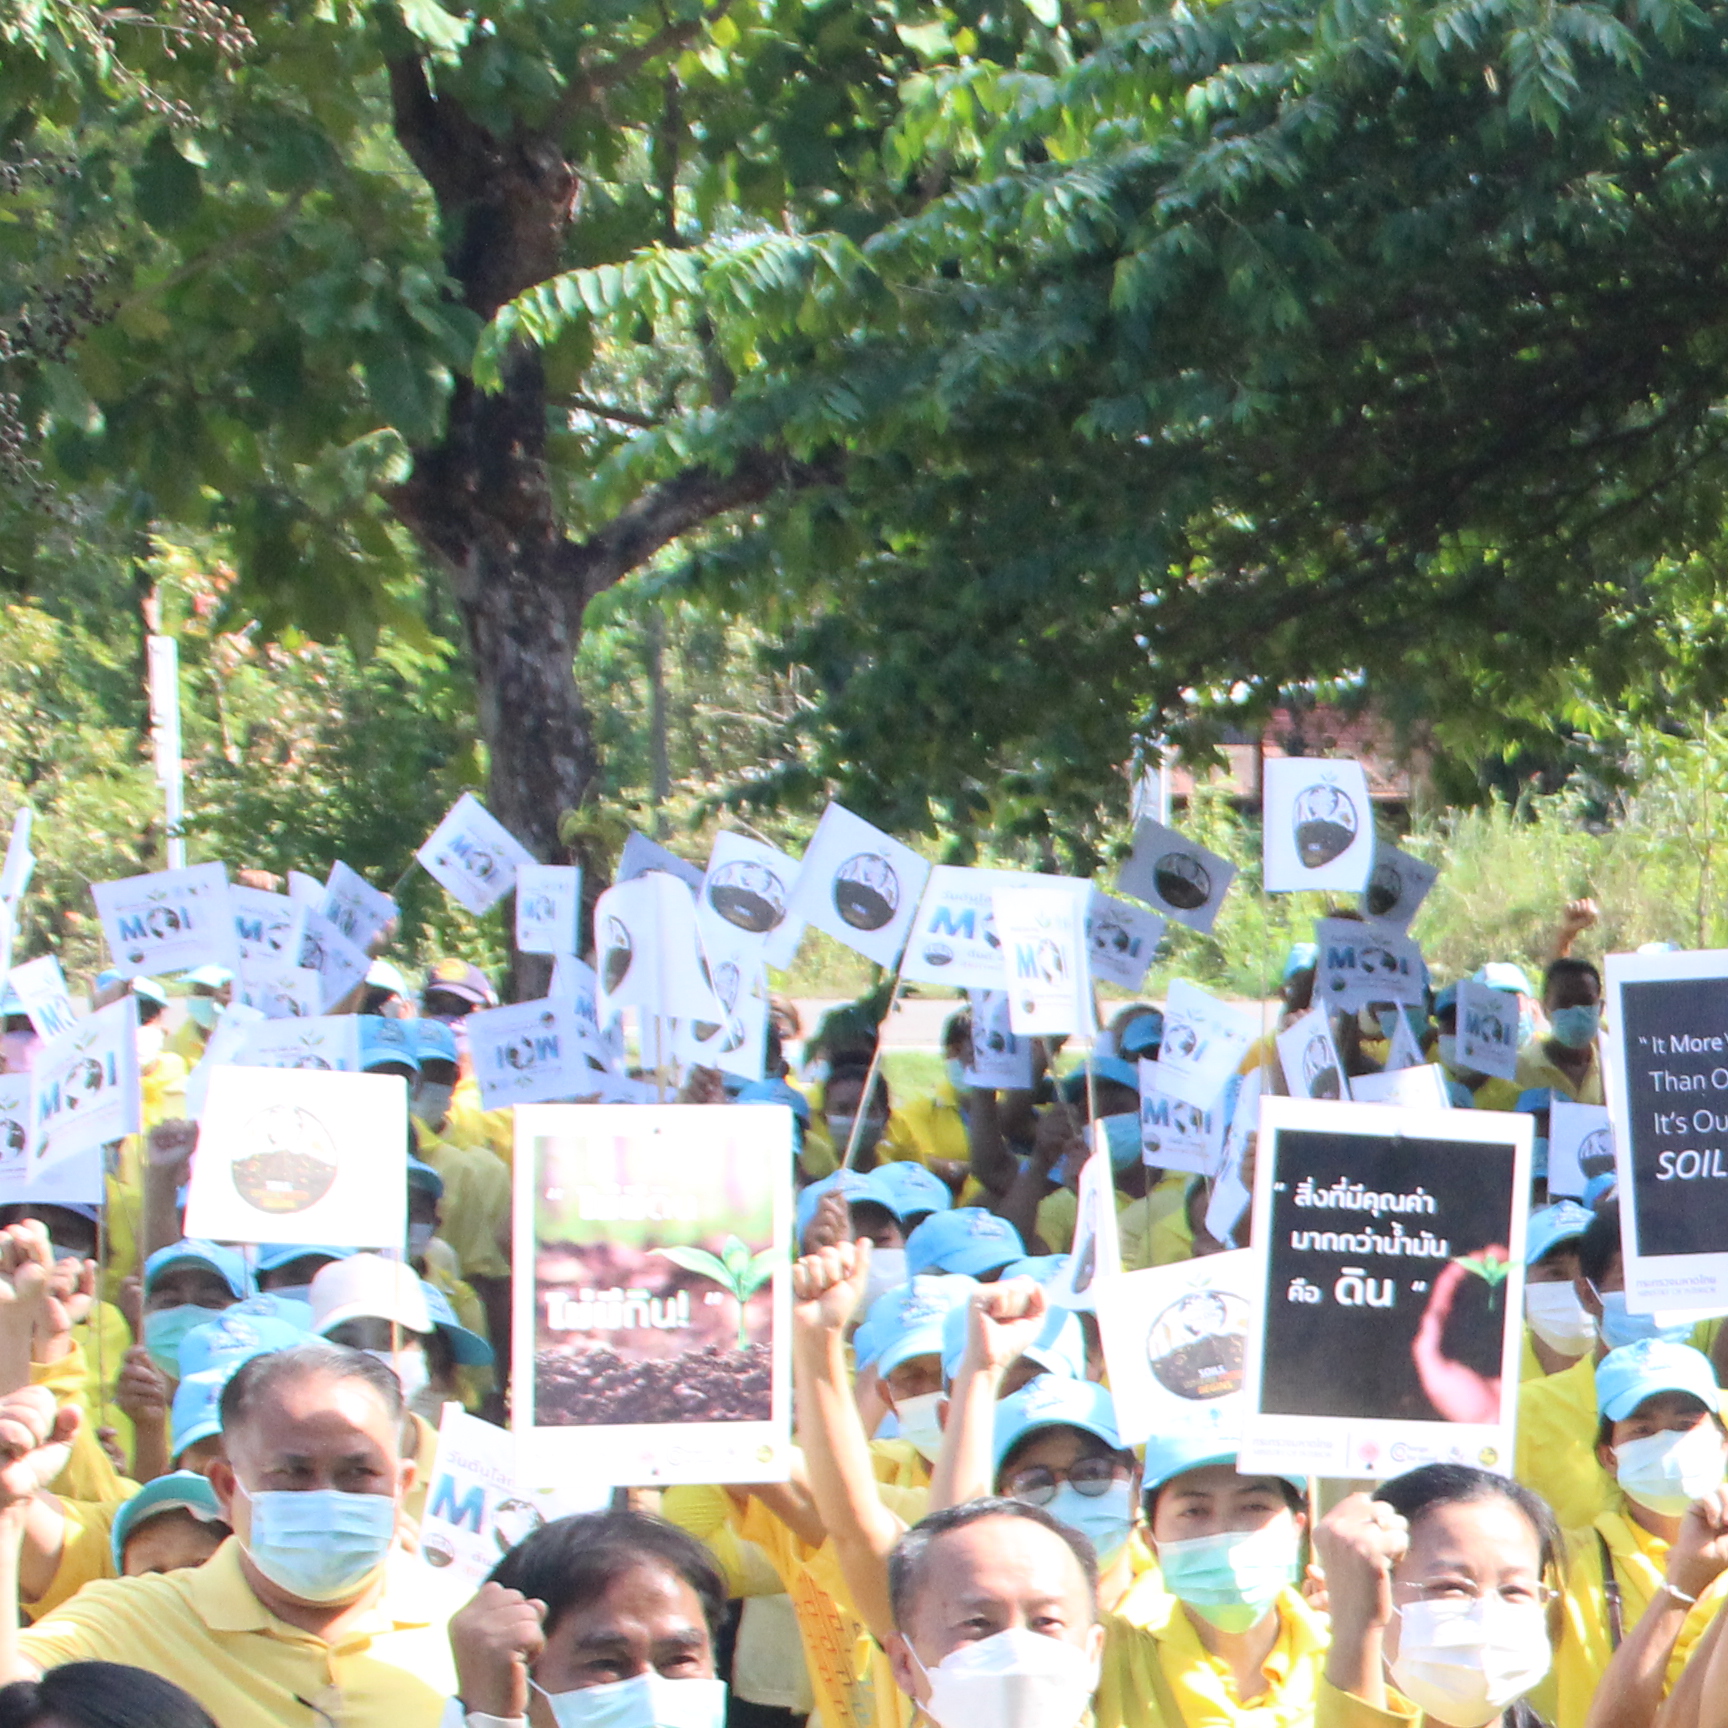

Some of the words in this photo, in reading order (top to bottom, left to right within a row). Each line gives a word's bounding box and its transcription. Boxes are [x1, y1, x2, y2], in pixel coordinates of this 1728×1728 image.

[1086, 917, 1141, 958] OI
[1165, 1023, 1208, 1062] OI
[1670, 1033, 1723, 1054] More
[1648, 1070, 1706, 1094] Than
[1293, 1176, 1436, 1218] สิ่งที่มีคุณค่า
[1291, 1220, 1448, 1259] มากกว่าน้ำมัน
[1287, 1277, 1321, 1304] คือ
[1334, 1266, 1396, 1308] ดิน
